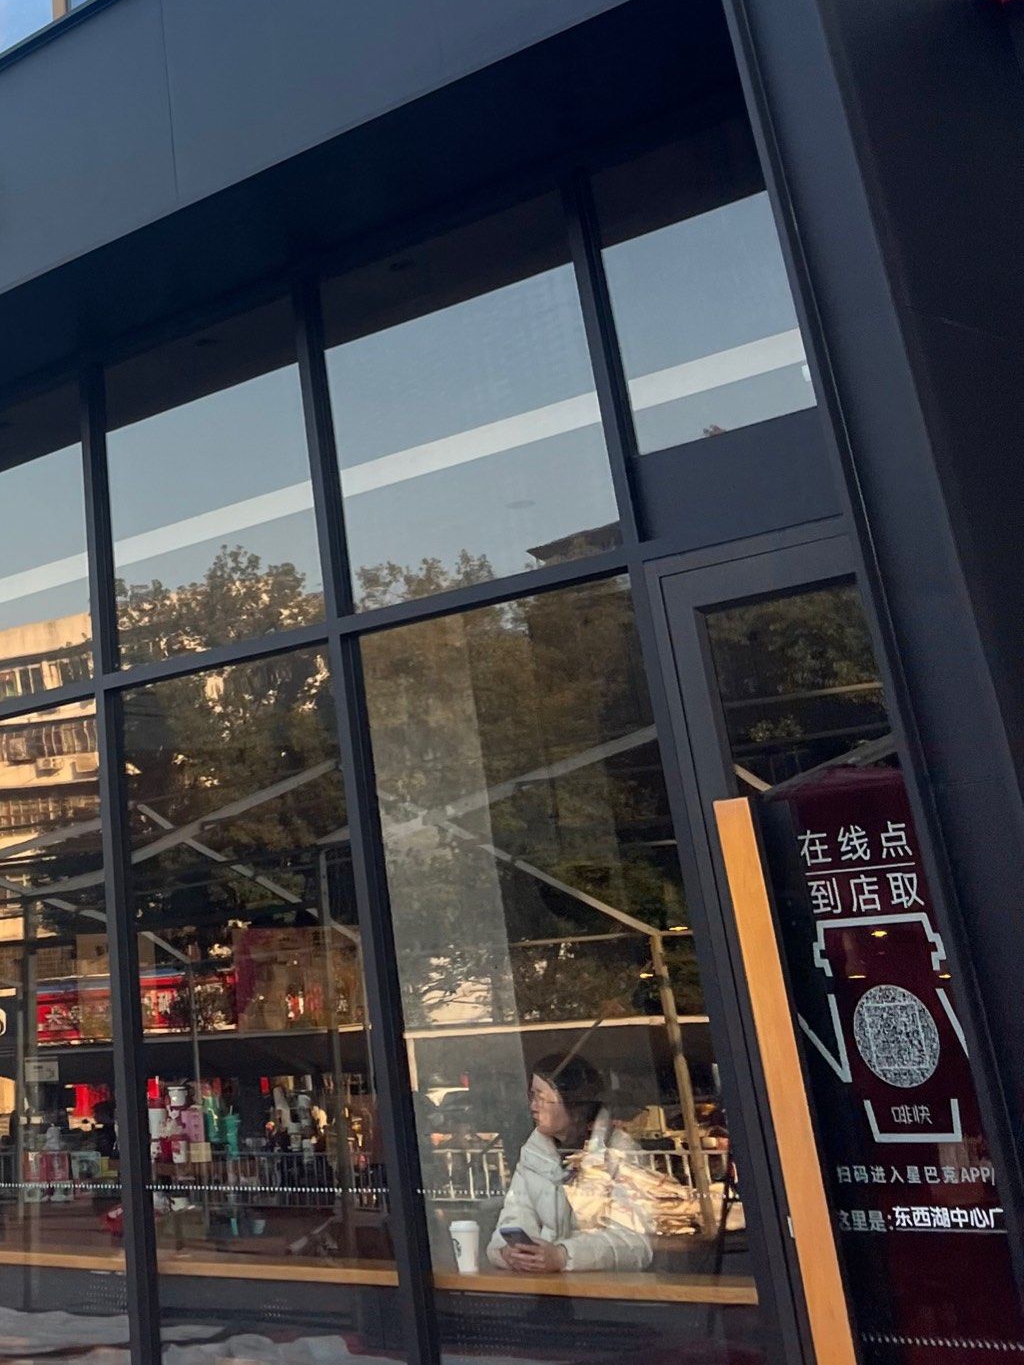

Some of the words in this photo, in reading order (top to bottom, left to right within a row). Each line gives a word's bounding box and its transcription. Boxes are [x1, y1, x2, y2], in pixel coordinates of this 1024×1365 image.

[797, 820, 914, 867] 在线点
[807, 872, 926, 915] 到店取
[891, 1105, 933, 1124] 啡快
[836, 1165, 996, 1186] 扫码进入星巴克APP
